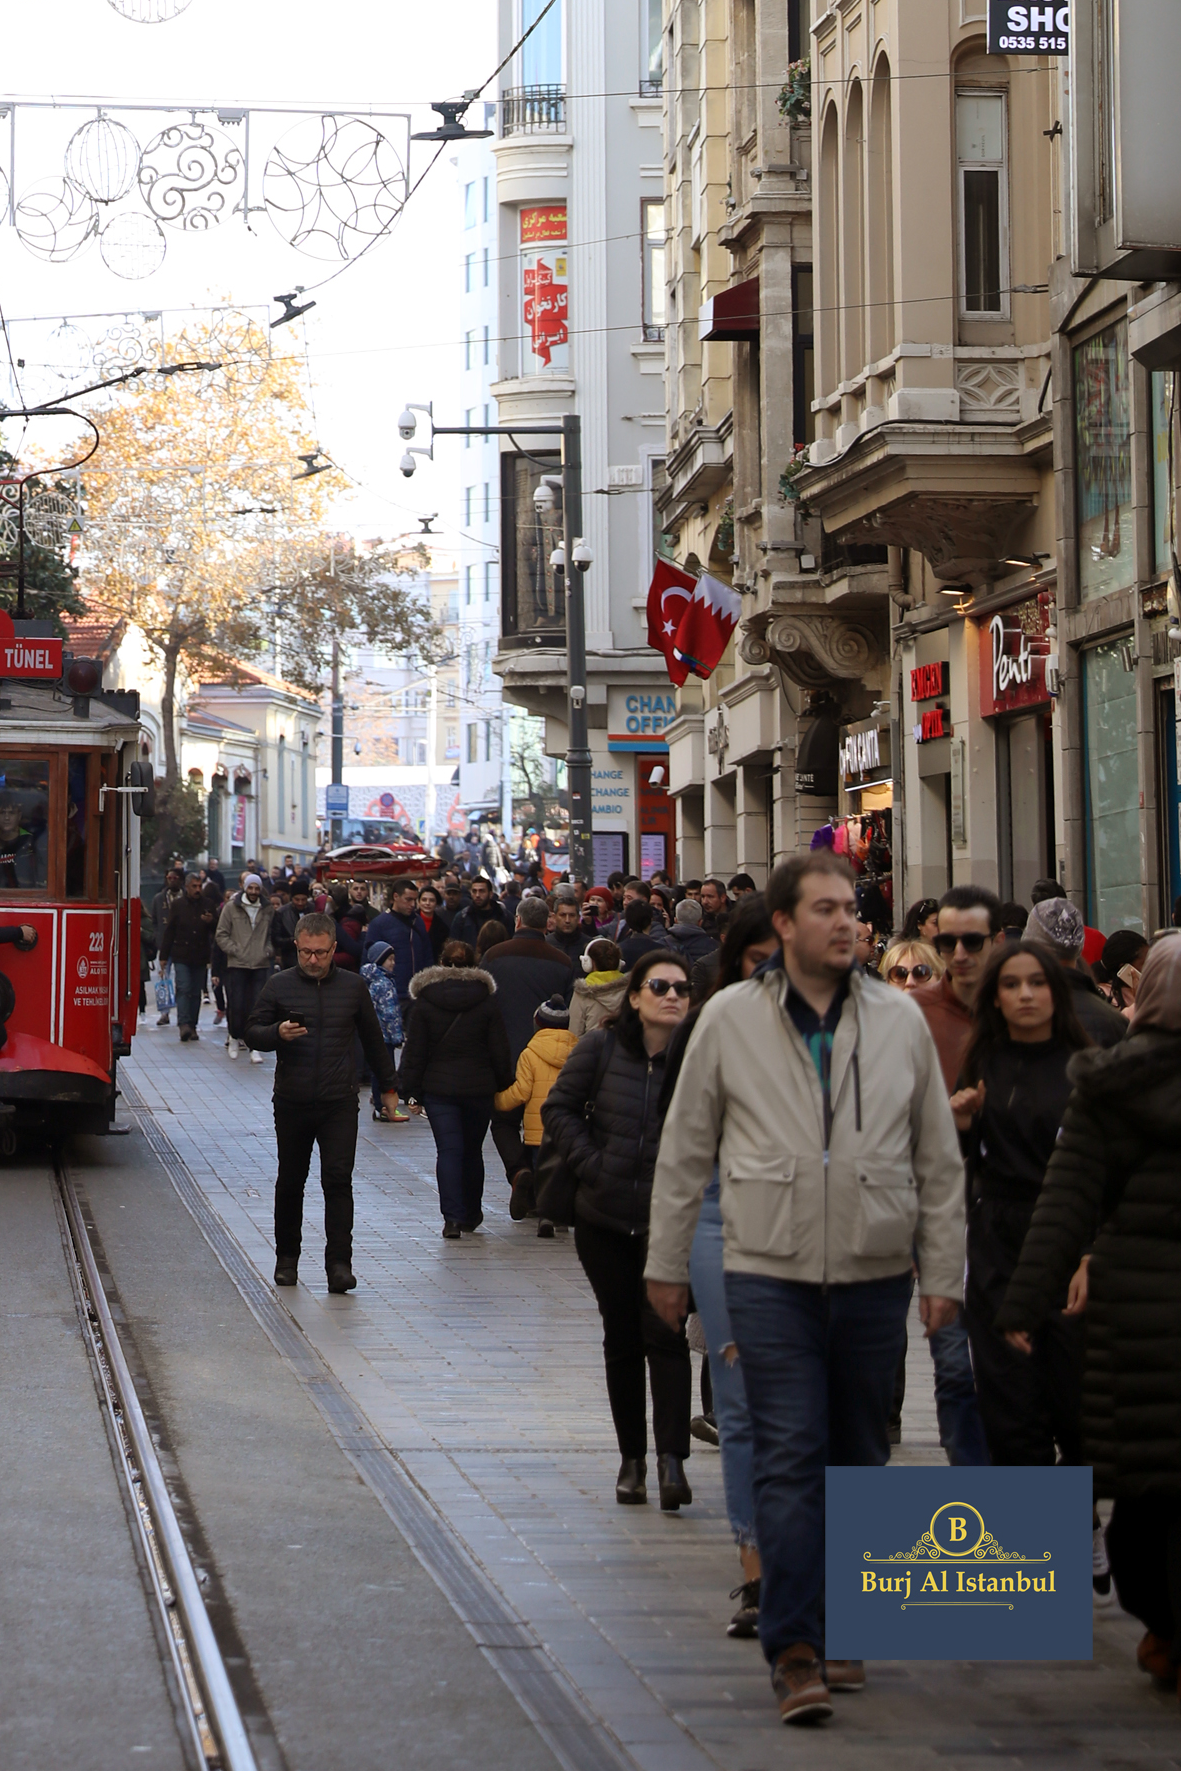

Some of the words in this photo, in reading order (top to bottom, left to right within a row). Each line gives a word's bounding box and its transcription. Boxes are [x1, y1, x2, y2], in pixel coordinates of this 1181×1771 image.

[999, 35, 1035, 49] 0535
[1039, 36, 1067, 50] 515
[4, 643, 53, 669] TÜNEL
[910, 660, 943, 702] EMGEN
[88, 932, 104, 952] 223
[73, 997, 81, 1006] VE
